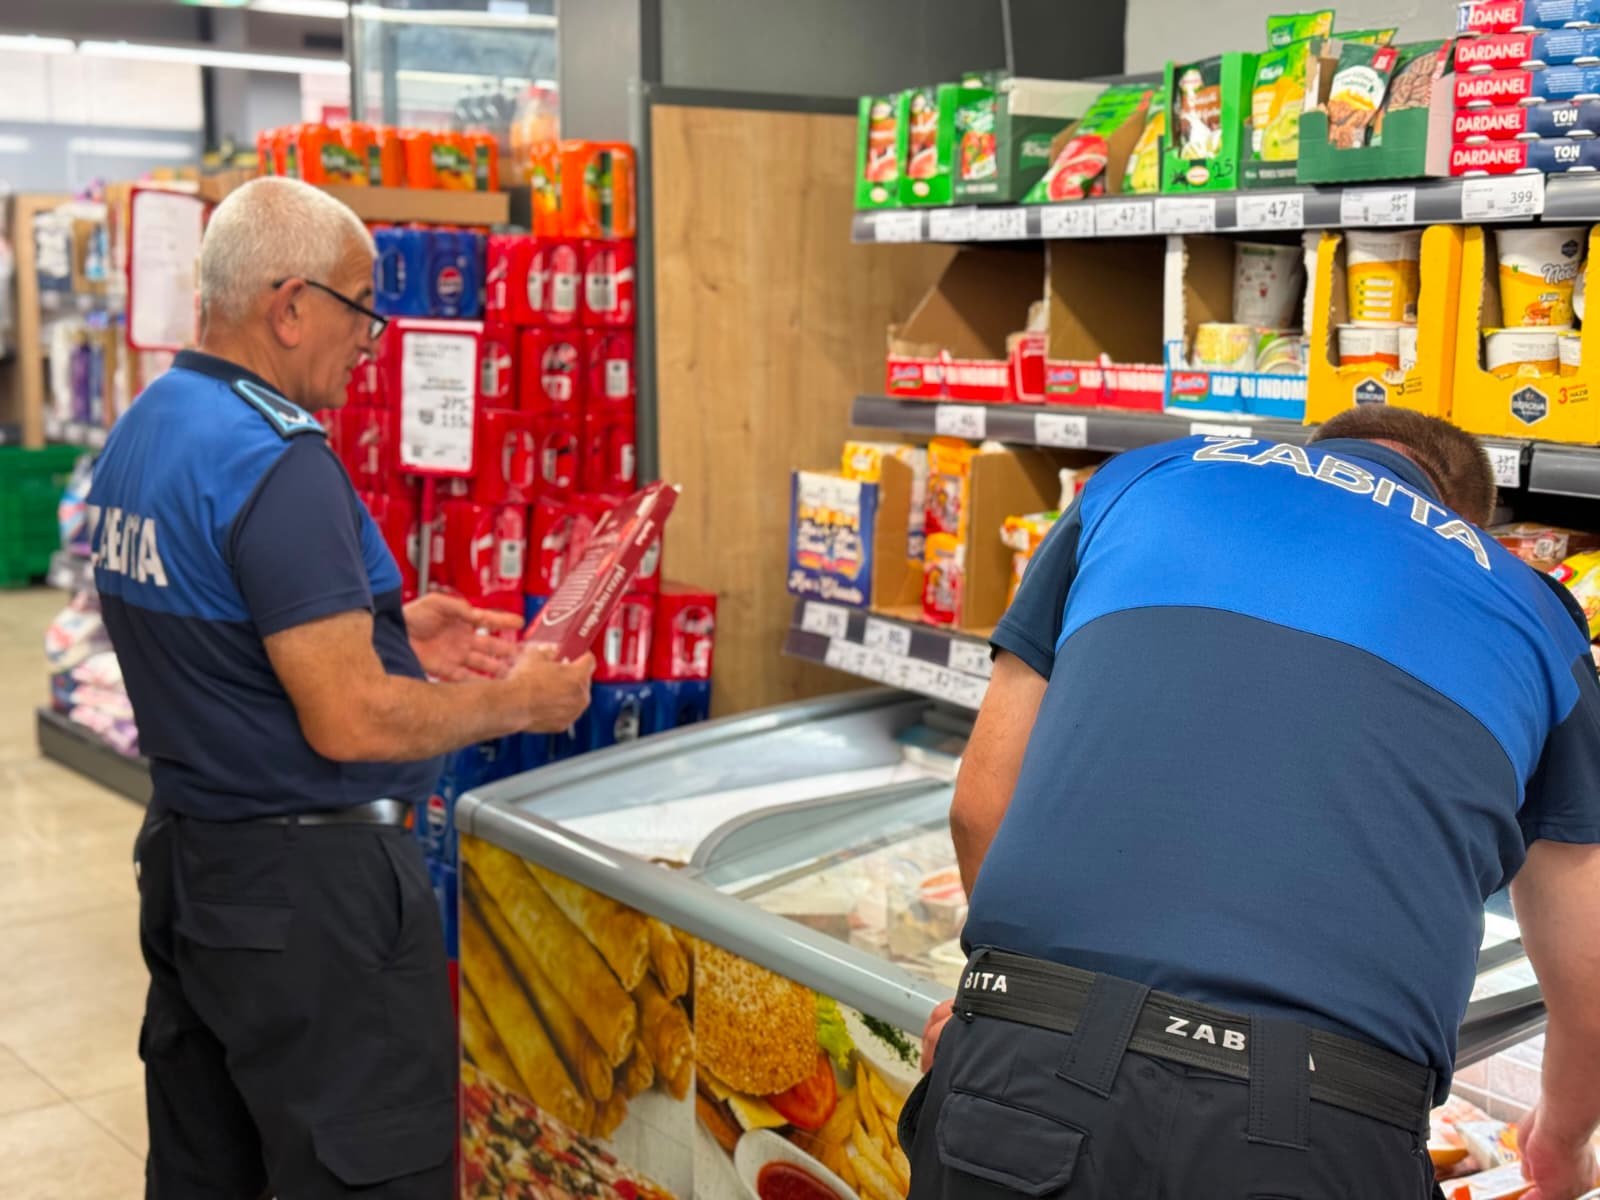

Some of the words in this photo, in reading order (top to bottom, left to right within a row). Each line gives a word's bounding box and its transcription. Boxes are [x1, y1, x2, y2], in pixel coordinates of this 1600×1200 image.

[1468, 7, 1518, 26] DANEL
[1459, 41, 1527, 62] DARDANEL
[1457, 77, 1527, 98] DARDANEL
[1455, 113, 1523, 133] DARDANEL
[1552, 109, 1578, 123] TON
[1452, 147, 1522, 167] DARDANEL
[1553, 145, 1580, 159] TON
[1558, 387, 1568, 404] 3
[1192, 436, 1491, 571] ZABITA
[1164, 1015, 1246, 1052] ZAB
